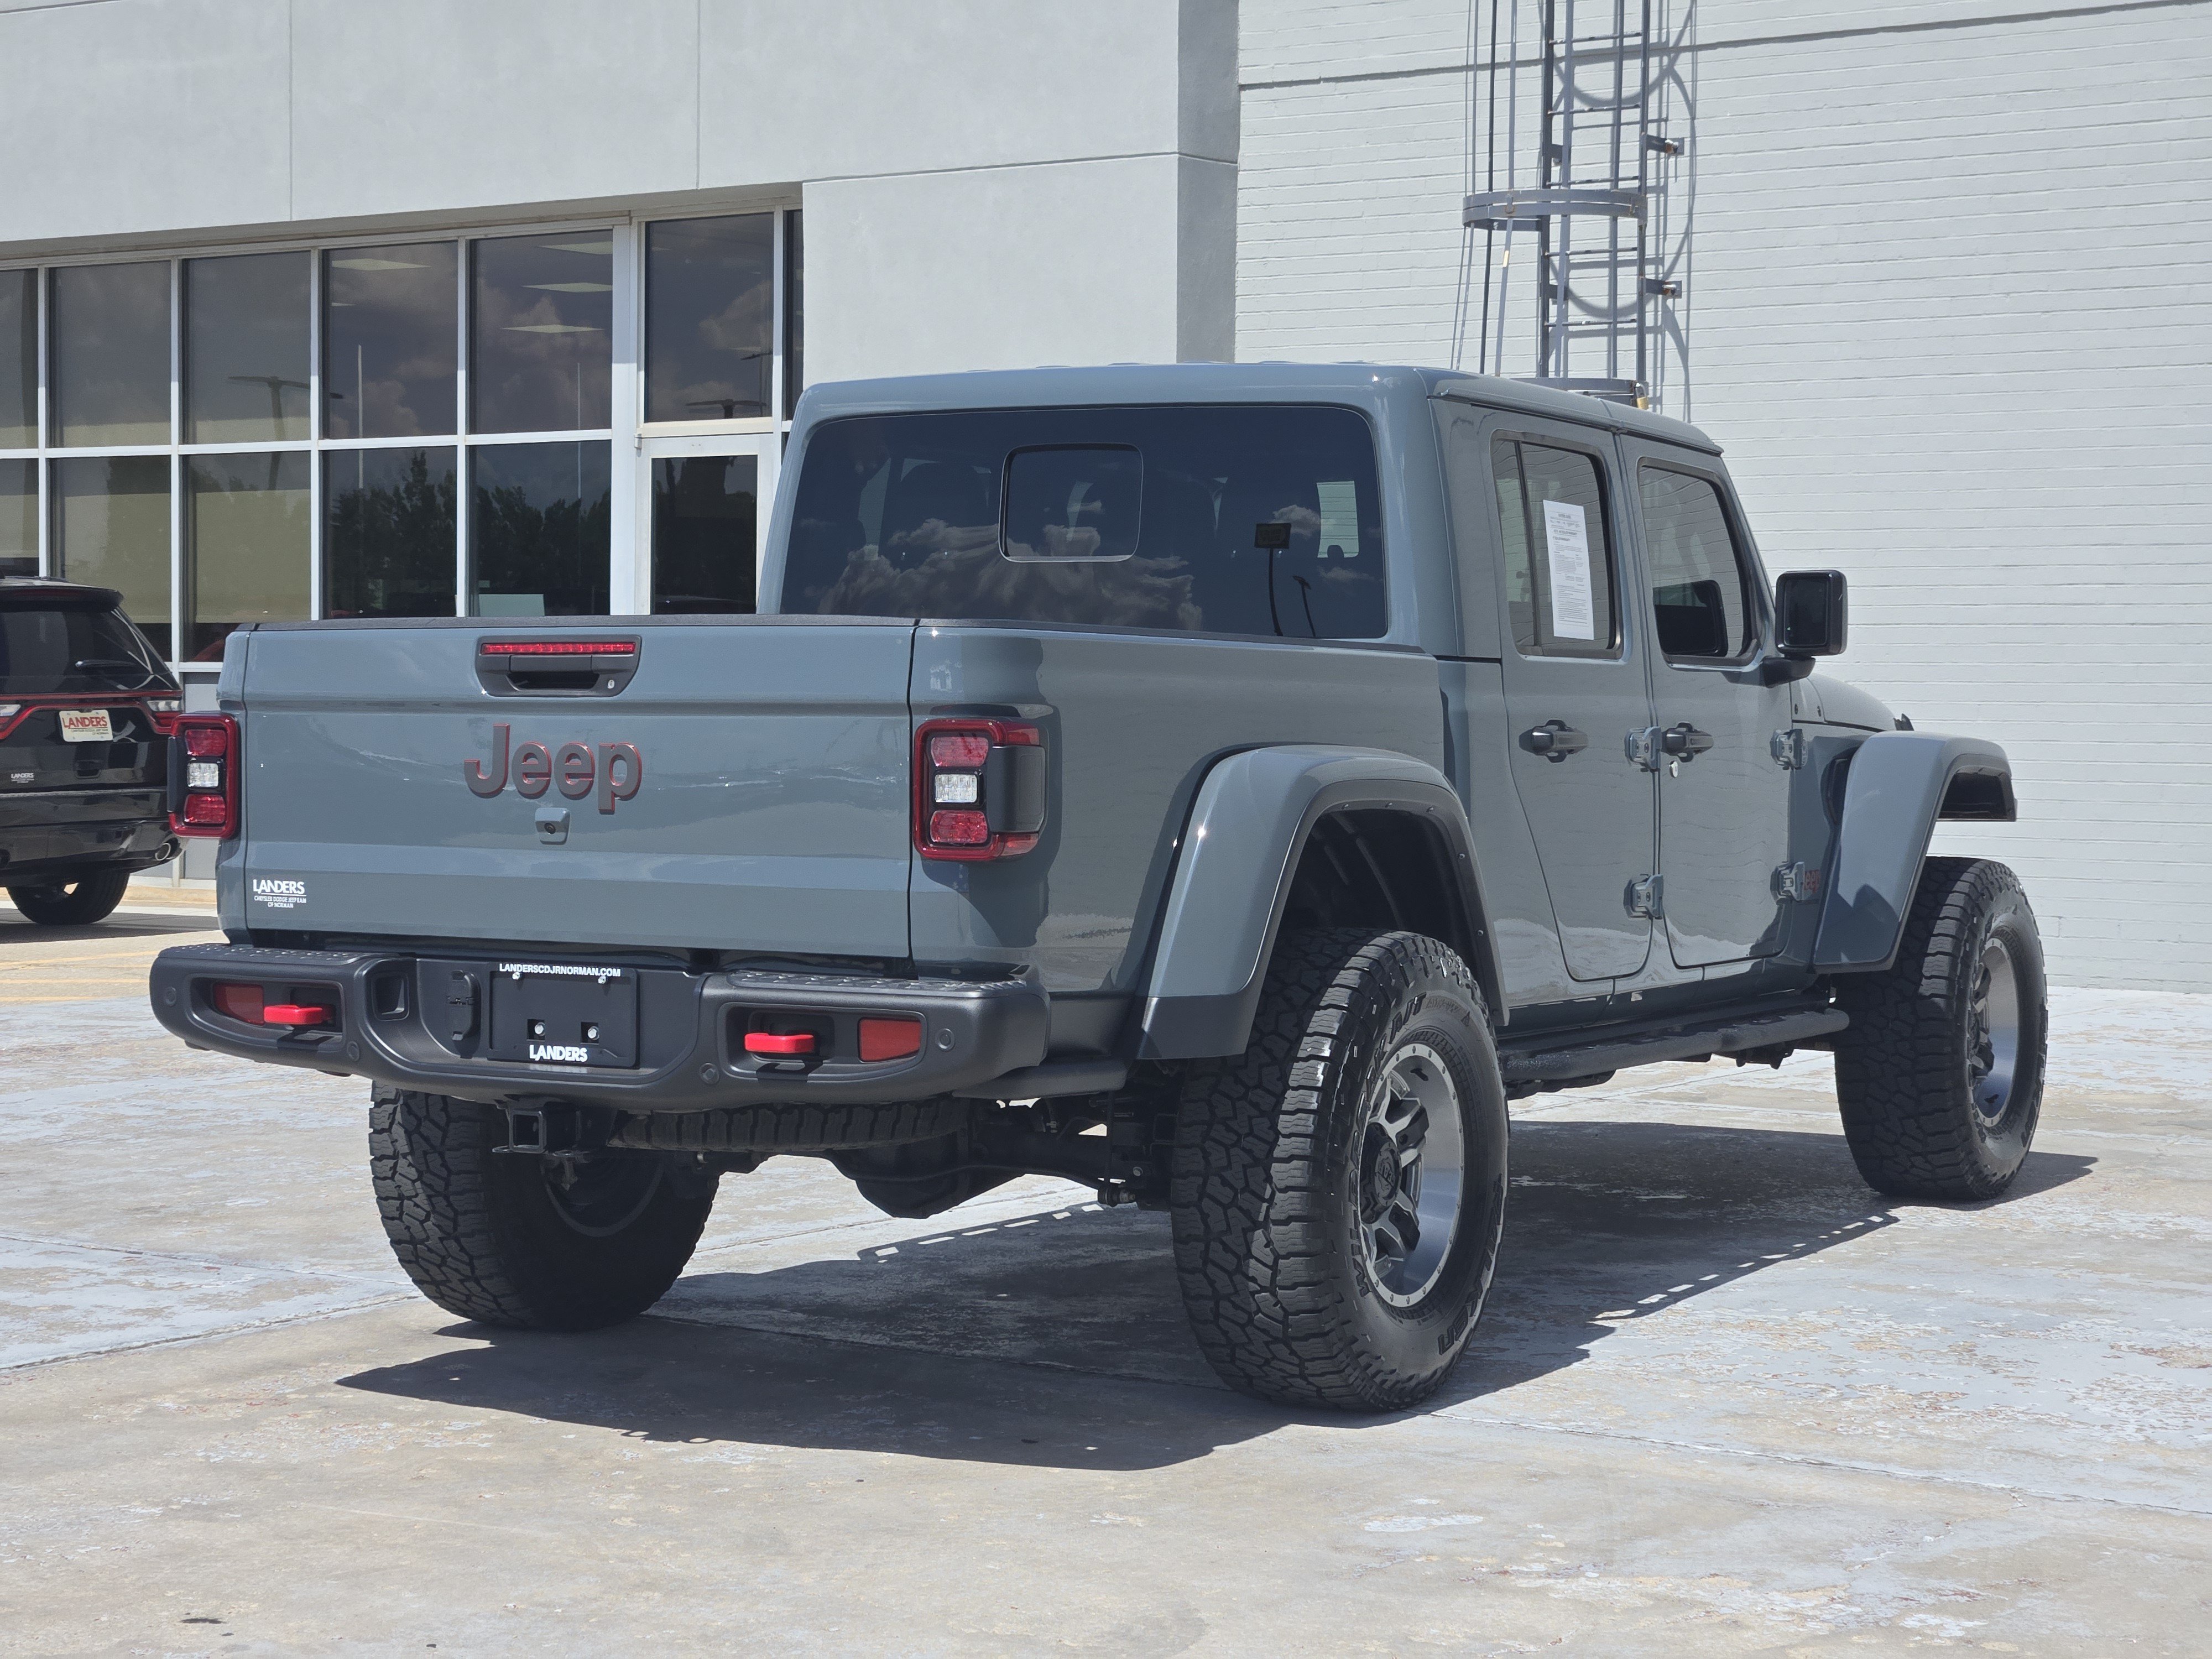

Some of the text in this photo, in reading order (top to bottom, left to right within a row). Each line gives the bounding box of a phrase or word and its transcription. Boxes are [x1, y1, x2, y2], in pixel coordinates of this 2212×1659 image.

[62, 716, 108, 729] LANDERS
[464, 723, 642, 815] Jeep
[253, 879, 305, 894] LANDERS
[499, 963, 621, 977] LANDERSCDJRNORMAN.COM
[529, 1044, 588, 1062] LANDERS
